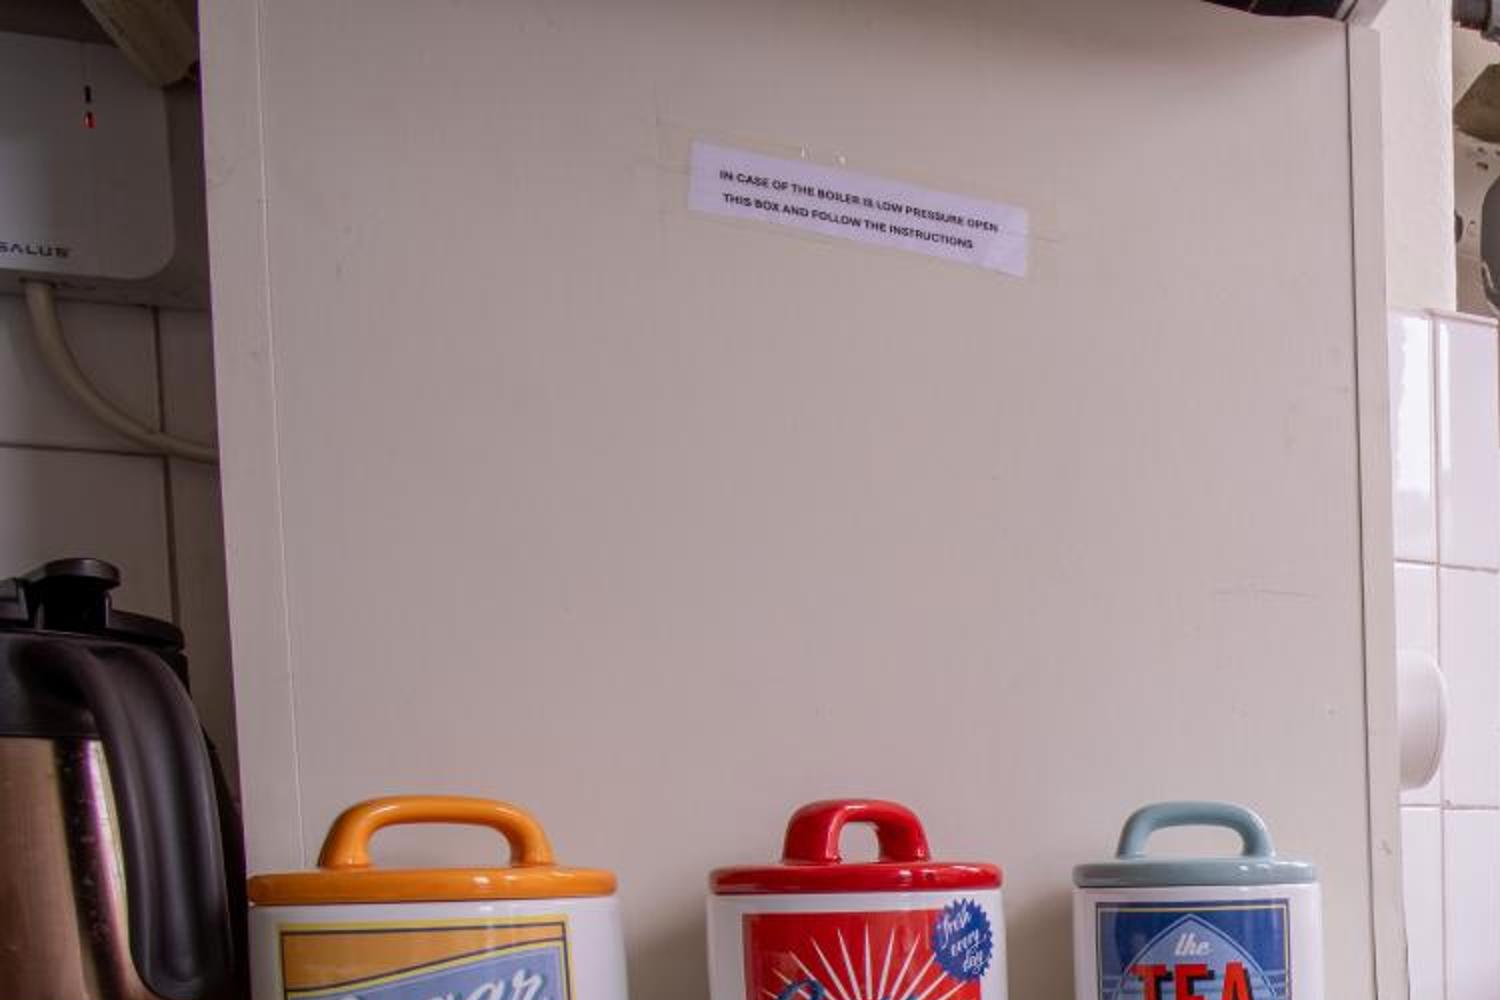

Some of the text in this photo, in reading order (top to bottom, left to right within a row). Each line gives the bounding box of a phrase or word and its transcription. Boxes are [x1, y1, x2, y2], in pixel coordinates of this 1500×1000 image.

[720, 170, 999, 232] IN CASE OF THE BOILER IS LOW PRESSURE OPEN
[723, 193, 974, 249] THIS BOX AND FOLLOW THE INSTRUCTIONS
[1174, 932, 1214, 957] the
